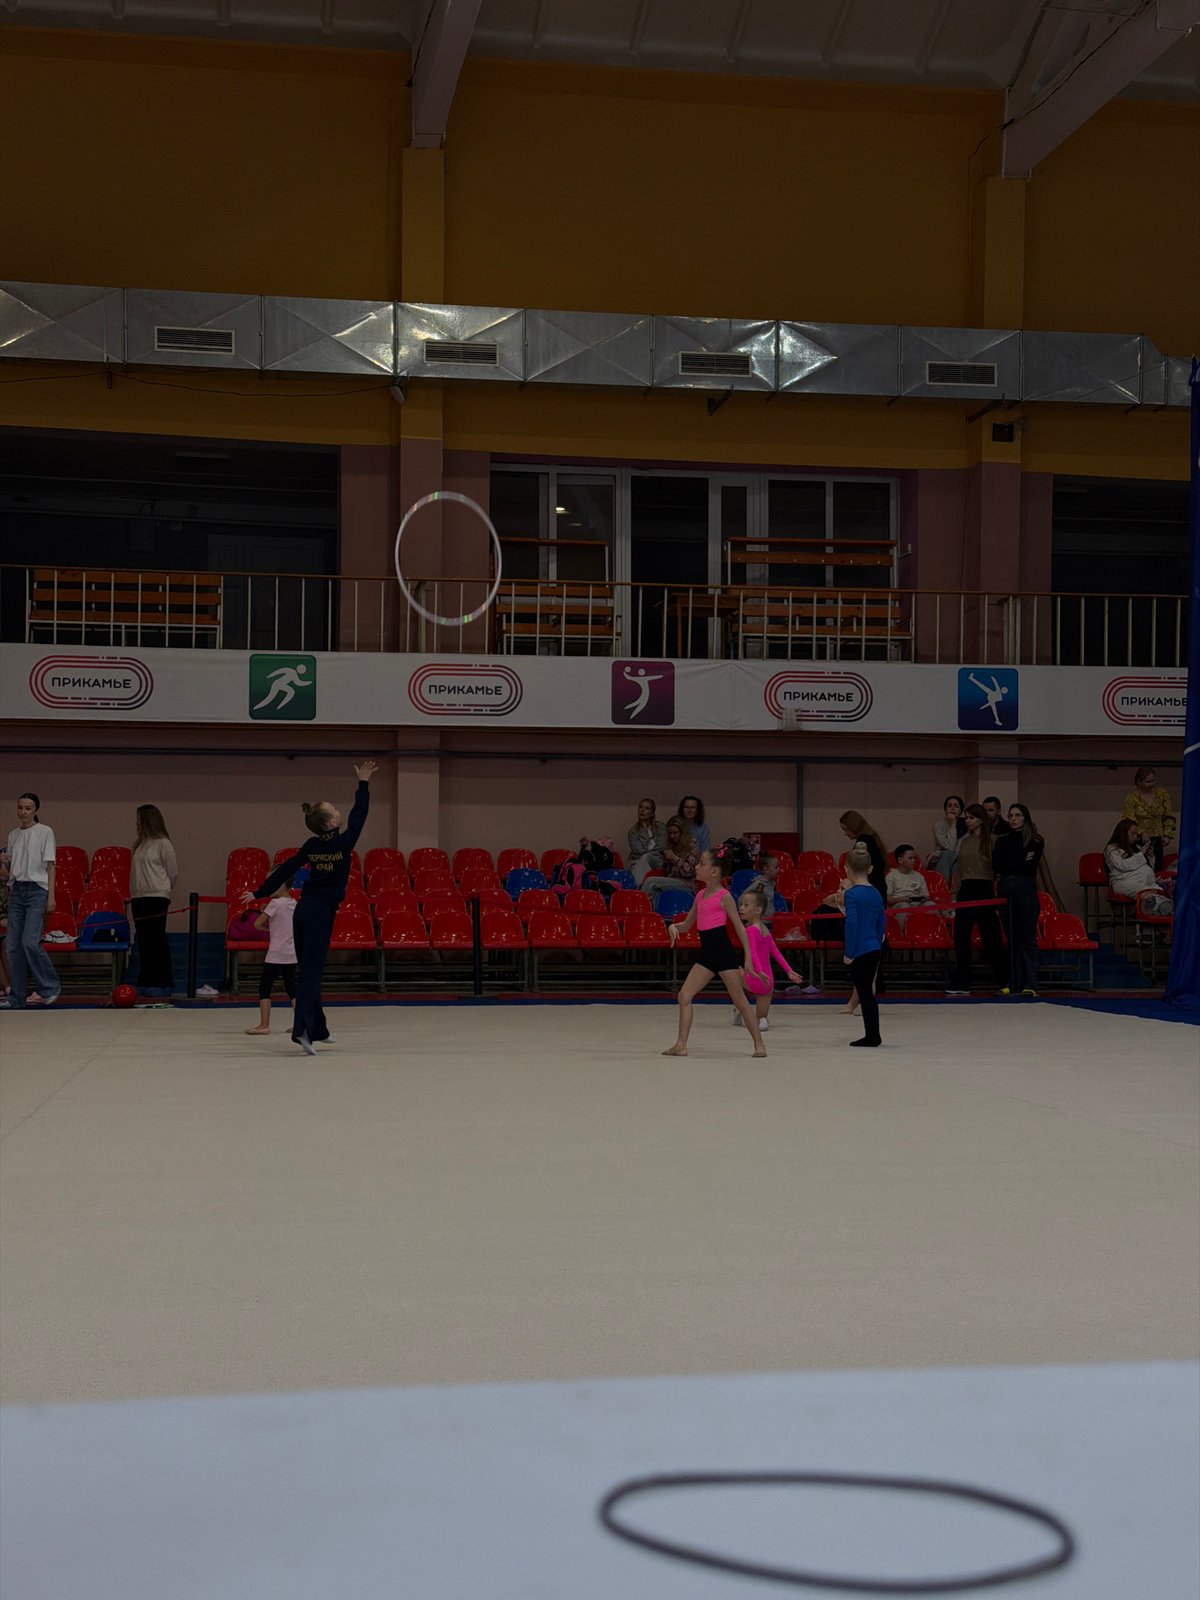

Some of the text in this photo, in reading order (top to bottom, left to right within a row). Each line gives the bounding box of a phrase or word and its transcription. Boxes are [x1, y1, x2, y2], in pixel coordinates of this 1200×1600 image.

[51, 677, 132, 689] ПРИКАМЬЕ
[428, 684, 503, 696] ПРИКАМЬЕ
[783, 691, 854, 702] ПРИКАМЬЕ
[1121, 696, 1188, 707] ПРИКАМЬЕ
